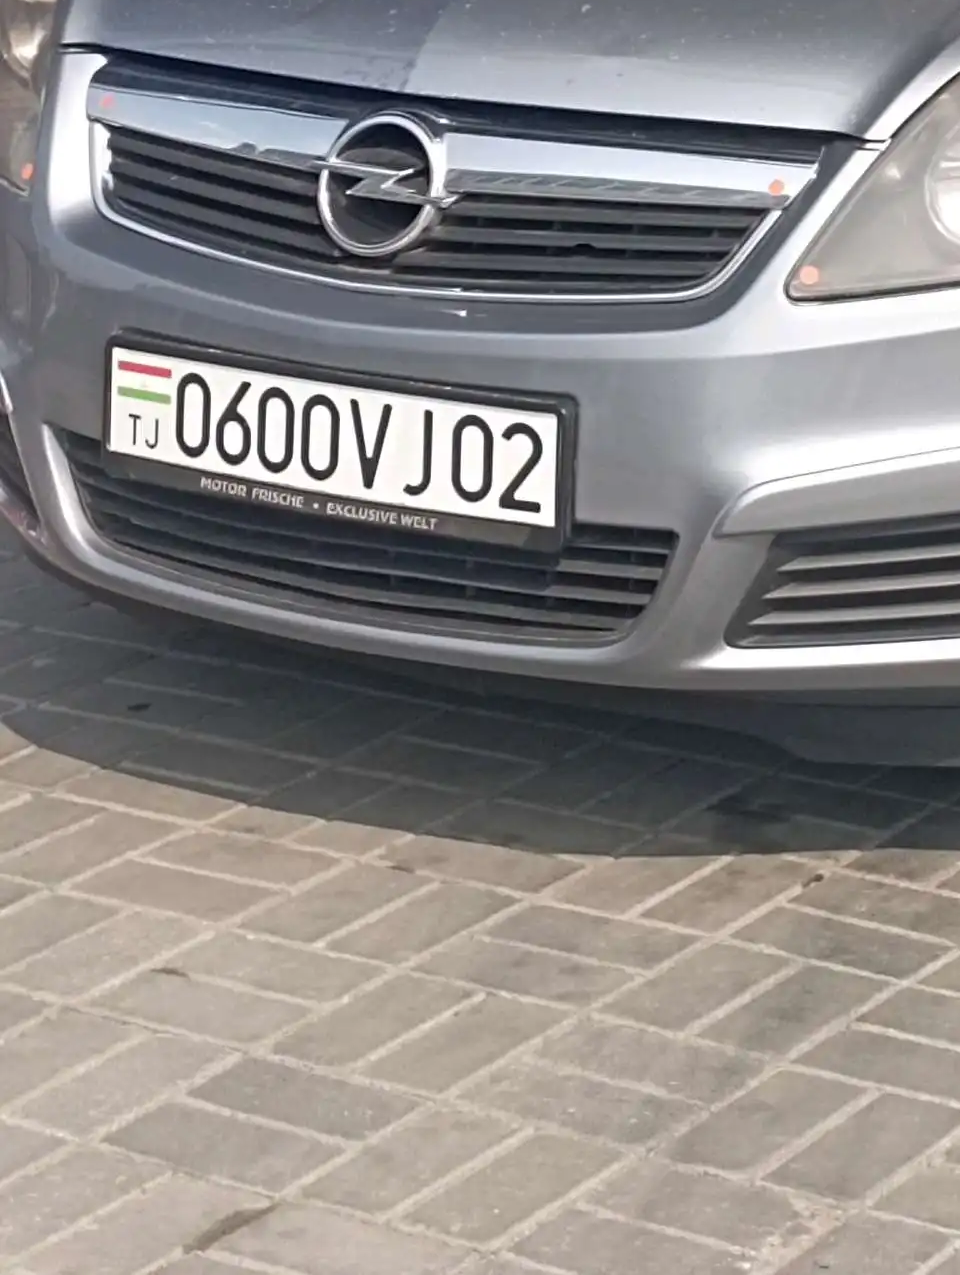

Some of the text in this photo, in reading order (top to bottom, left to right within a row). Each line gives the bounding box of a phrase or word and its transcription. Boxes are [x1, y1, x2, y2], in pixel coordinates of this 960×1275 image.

[128, 413, 160, 450] TJ
[175, 372, 543, 514] 0600VJ02
[200, 477, 438, 531] MOTOR FRISCHE EXCLUSIVE WELT
